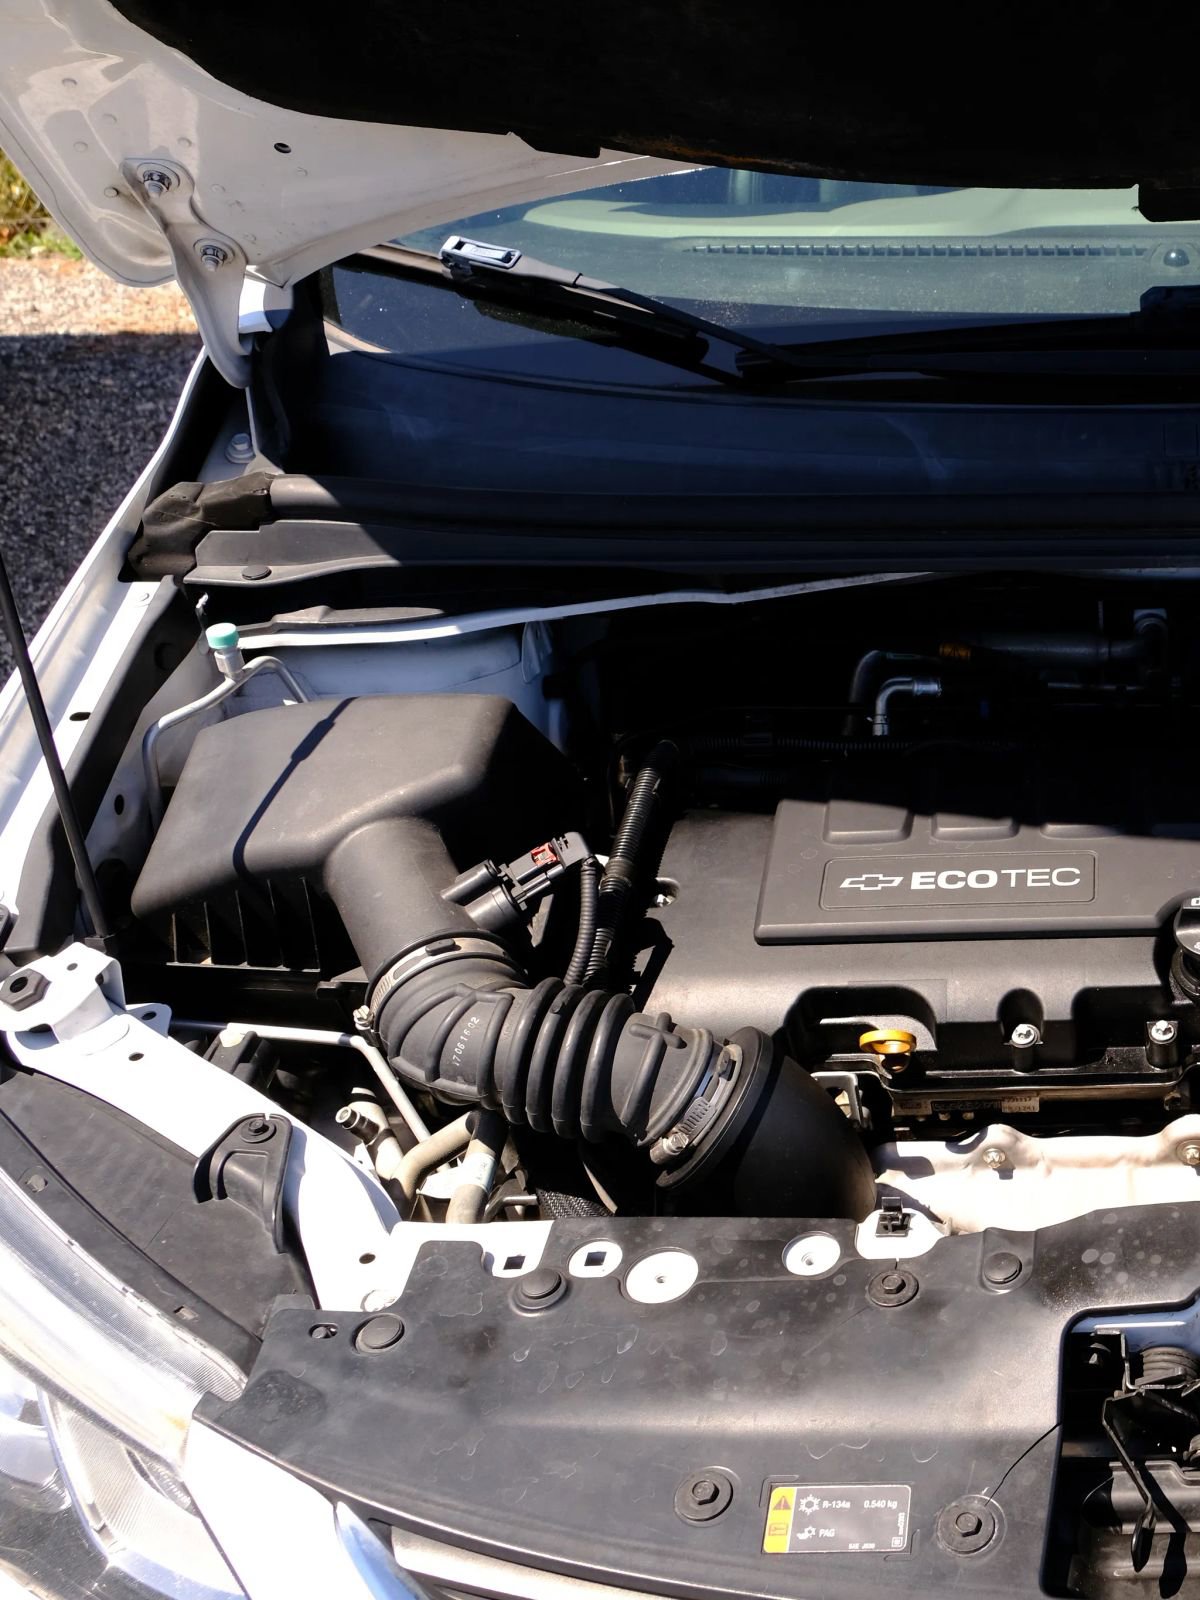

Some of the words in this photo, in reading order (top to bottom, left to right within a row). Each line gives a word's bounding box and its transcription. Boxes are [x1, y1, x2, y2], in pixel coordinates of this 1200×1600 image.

[910, 867, 1081, 890] ECOTEC
[864, 1500, 886, 1508] 0.540
[887, 1500, 898, 1510] kg
[819, 1528, 836, 1538] PAG
